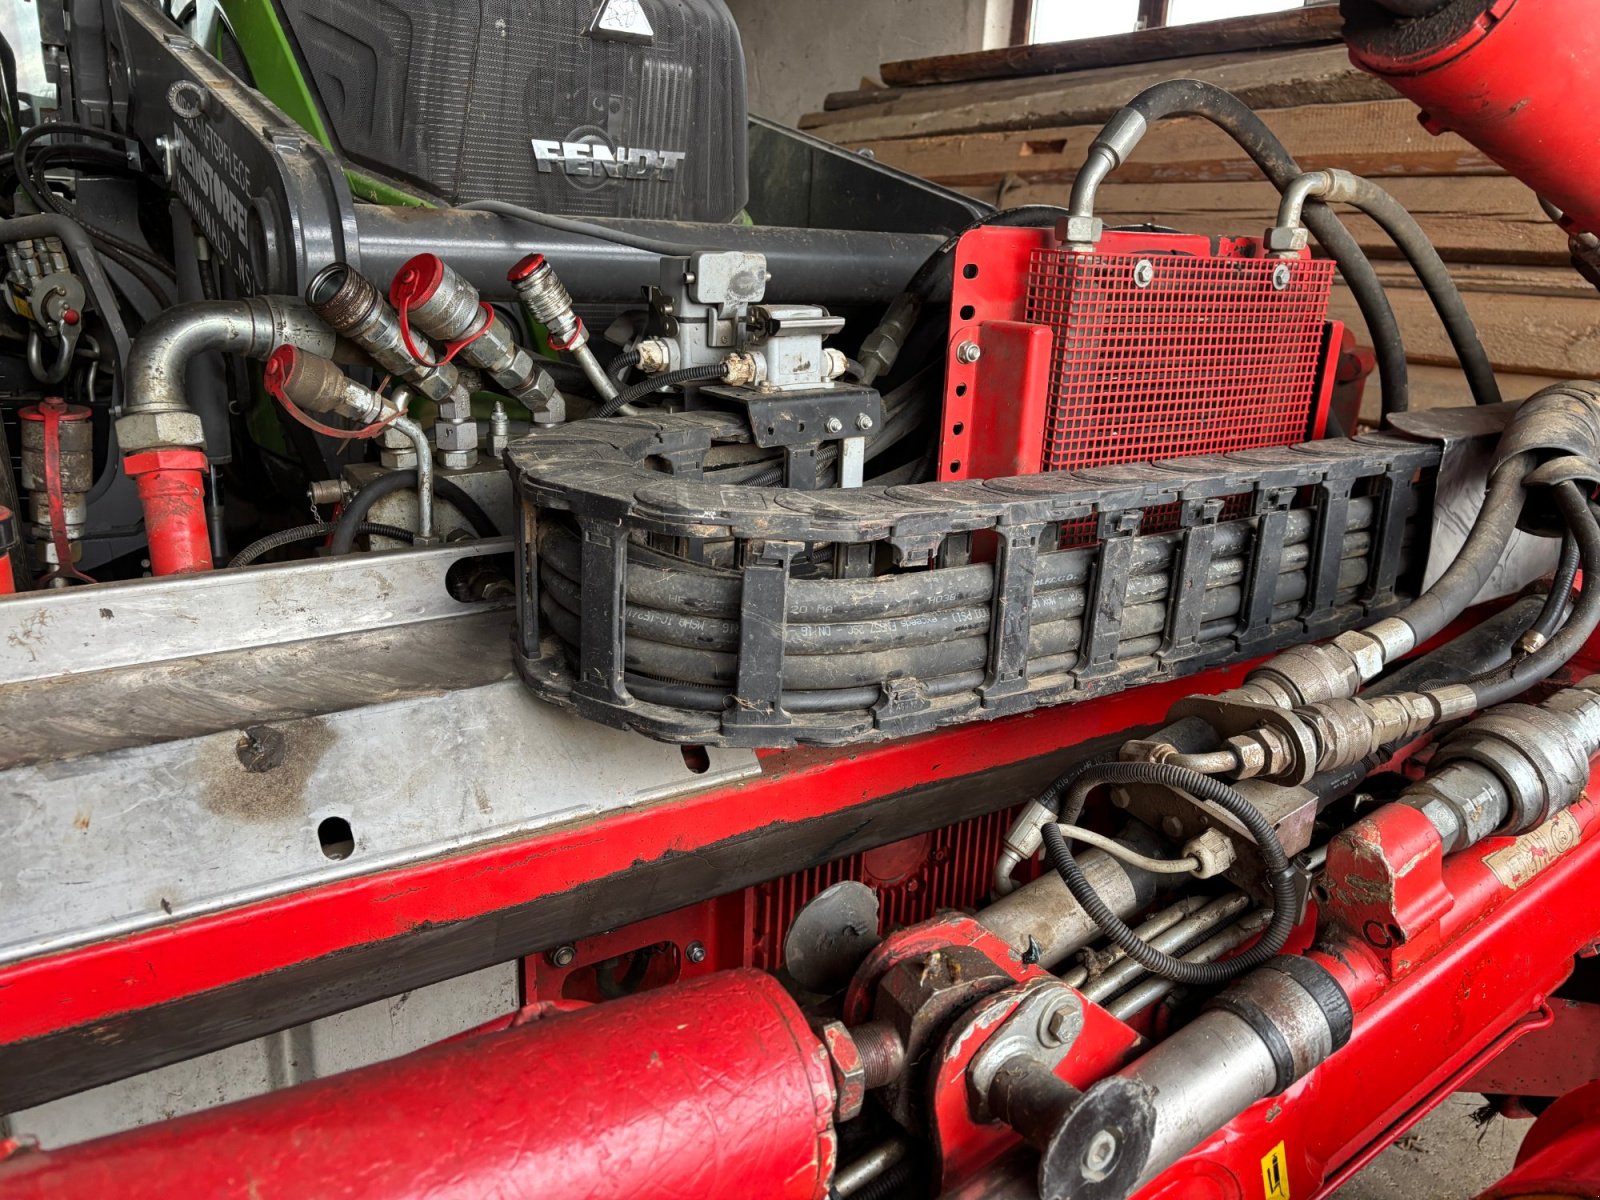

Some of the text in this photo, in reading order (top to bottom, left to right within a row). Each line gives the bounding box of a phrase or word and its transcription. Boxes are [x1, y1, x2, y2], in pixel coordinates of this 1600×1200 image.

[531, 139, 686, 181] FENDT
[901, 617, 938, 630] exceeds
[800, 626, 813, 637] 16
[818, 626, 832, 637] DN
